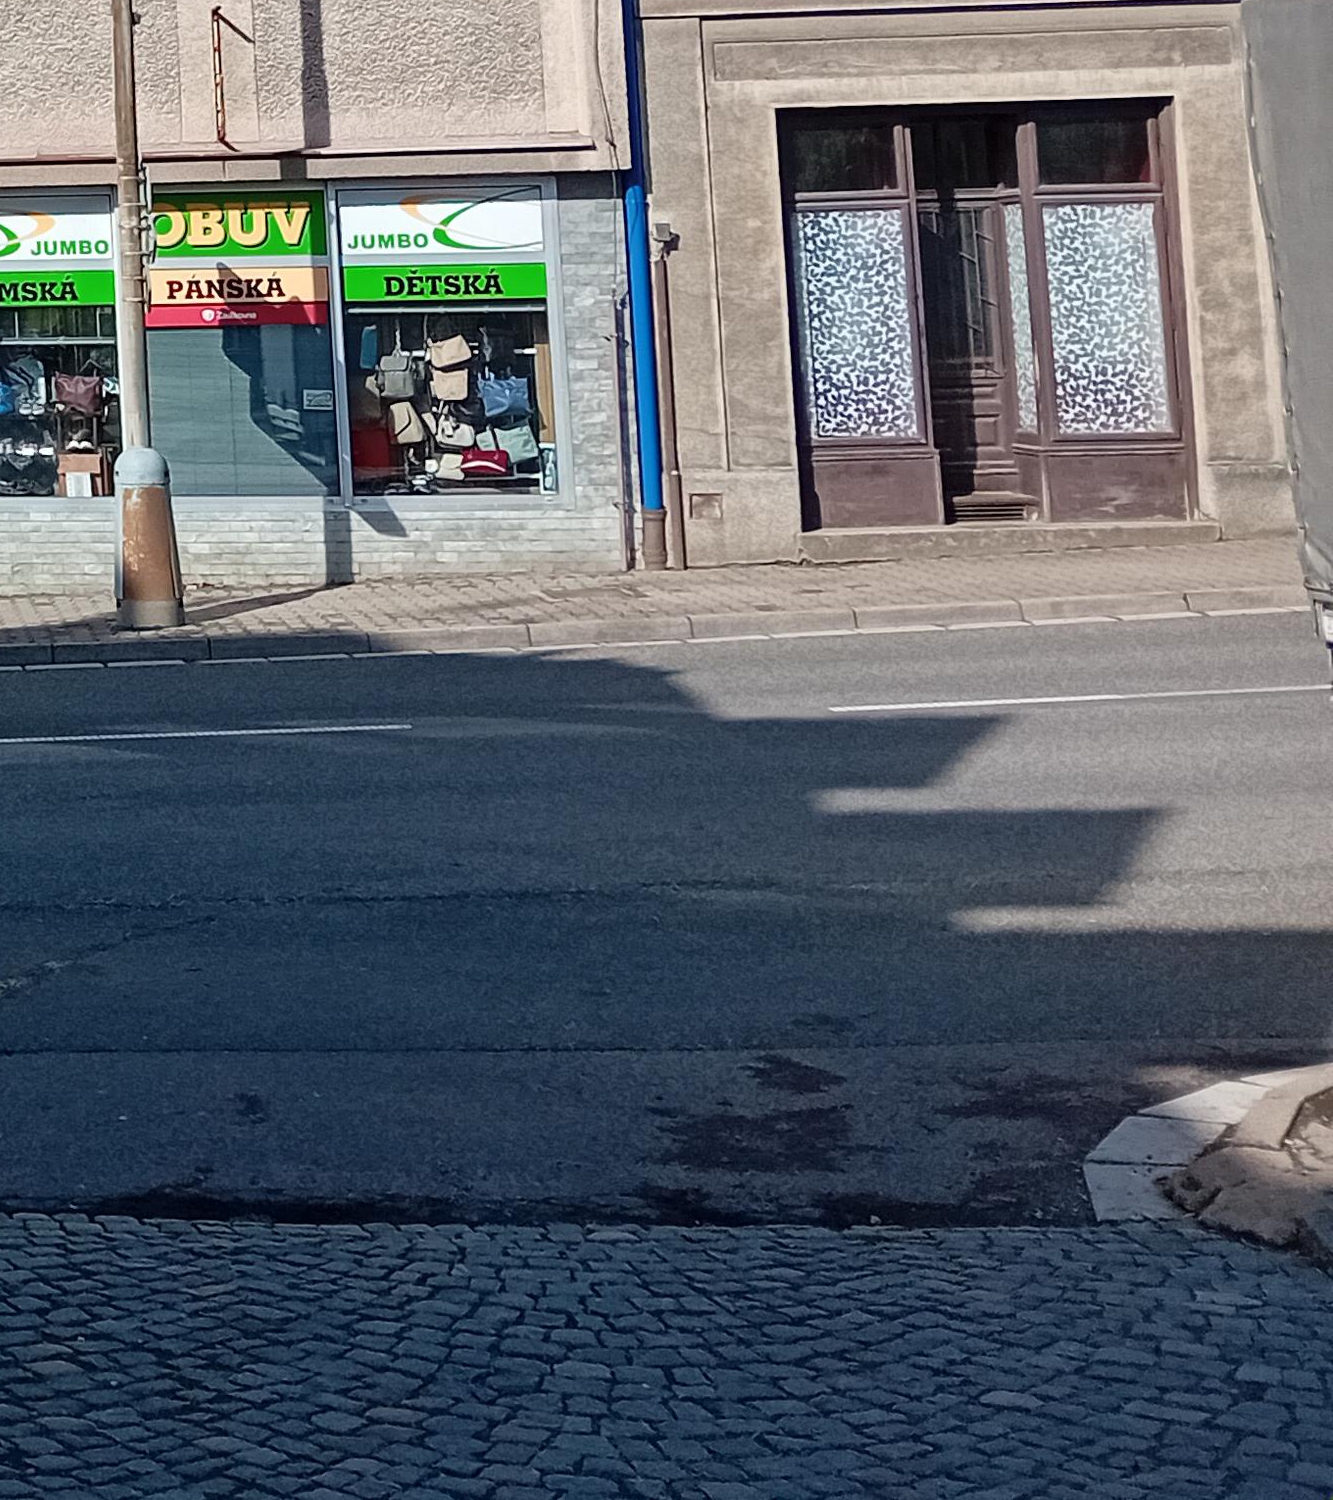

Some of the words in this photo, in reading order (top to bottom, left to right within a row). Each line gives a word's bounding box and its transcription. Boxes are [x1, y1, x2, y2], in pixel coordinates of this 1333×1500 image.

[153, 202, 310, 248] OBUV
[31, 240, 109, 256] JUMBO
[347, 233, 428, 250] JUMBO
[166, 274, 286, 300] PÁNSKÁ
[384, 270, 504, 296] DĚTSKÁ
